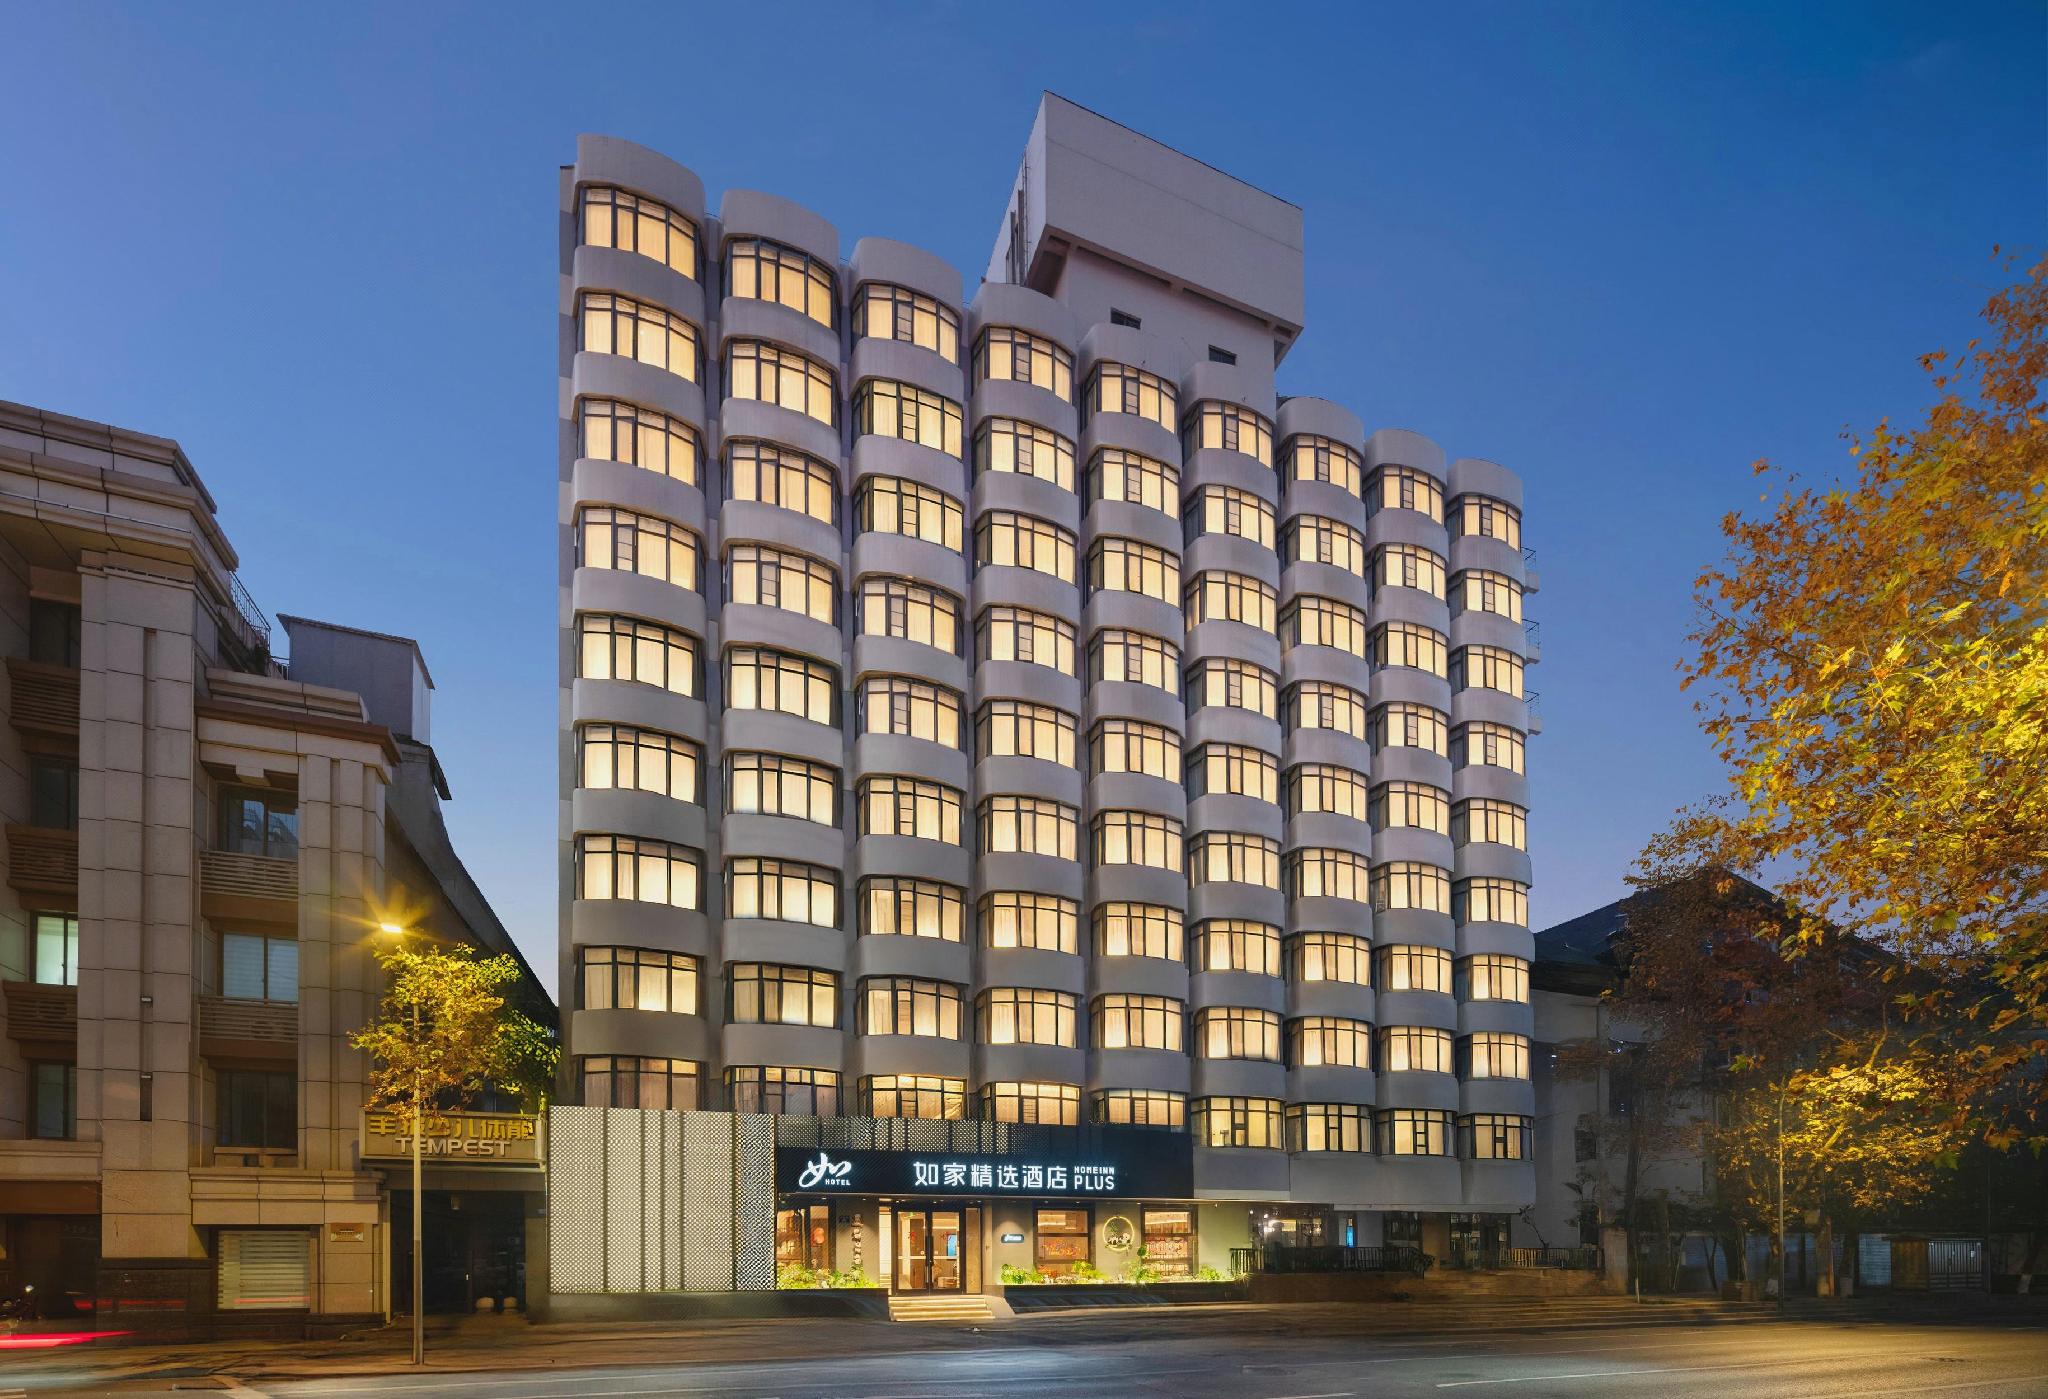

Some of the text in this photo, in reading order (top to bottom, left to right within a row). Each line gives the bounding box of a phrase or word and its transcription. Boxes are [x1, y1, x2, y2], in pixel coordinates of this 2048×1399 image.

[395, 1137, 512, 1157] TEMPEST
[825, 1178, 852, 1186] HOTEL
[913, 1161, 1068, 1190] 如家精选酒店
[1074, 1175, 1115, 1190] PLUS
